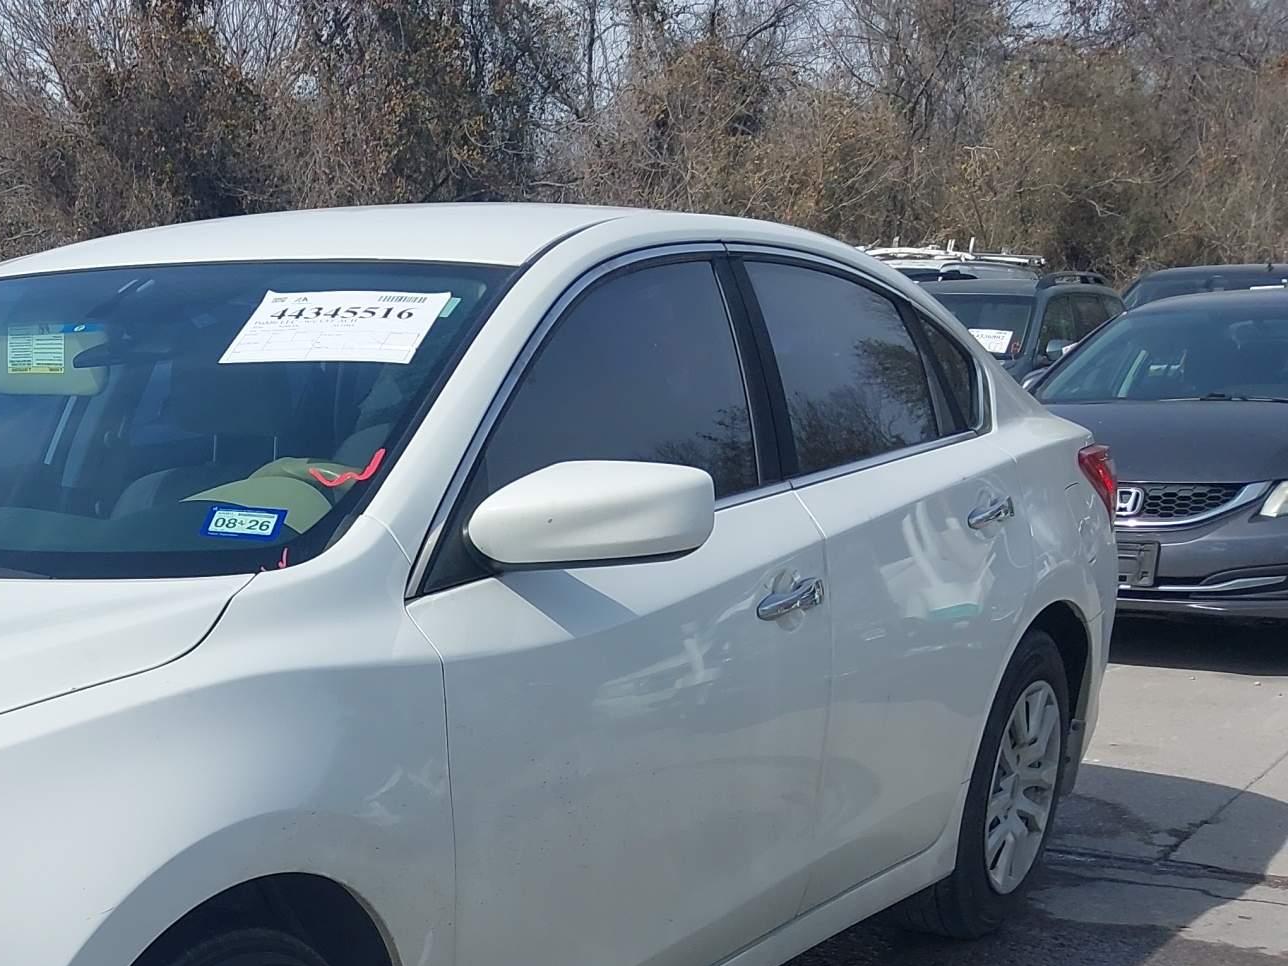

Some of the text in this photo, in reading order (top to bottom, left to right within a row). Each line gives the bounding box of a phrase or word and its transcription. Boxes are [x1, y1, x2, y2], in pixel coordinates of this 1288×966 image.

[270, 306, 415, 320] 44345516
[214, 517, 271, 531] 08 26
